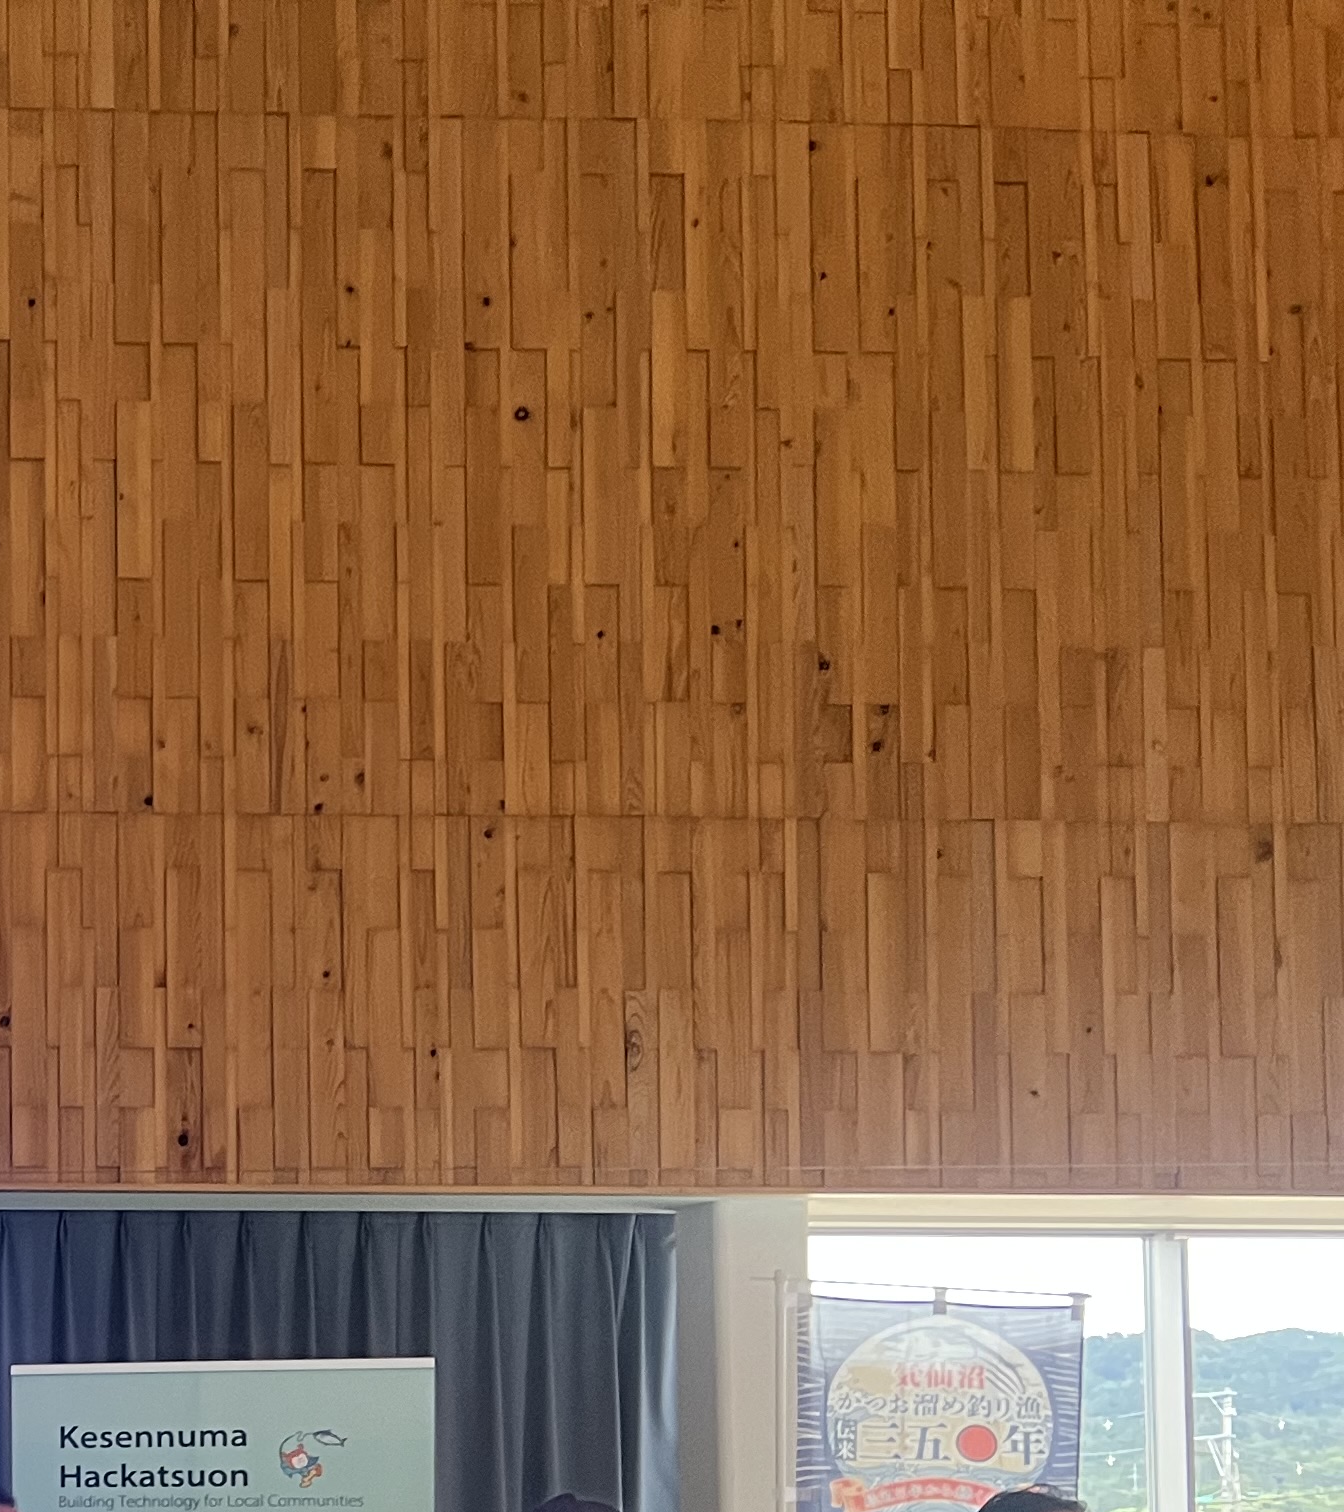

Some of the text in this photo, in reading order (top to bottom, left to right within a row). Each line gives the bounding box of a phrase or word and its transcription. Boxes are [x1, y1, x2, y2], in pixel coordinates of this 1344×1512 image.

[895, 1363, 987, 1391] 気仙沼
[60, 1425, 247, 1449] Kesennuma
[835, 1417, 857, 1461] 伝来
[60, 1463, 249, 1488] Hackatsuon
[58, 1493, 365, 1512] Building Technology for Local Communities
